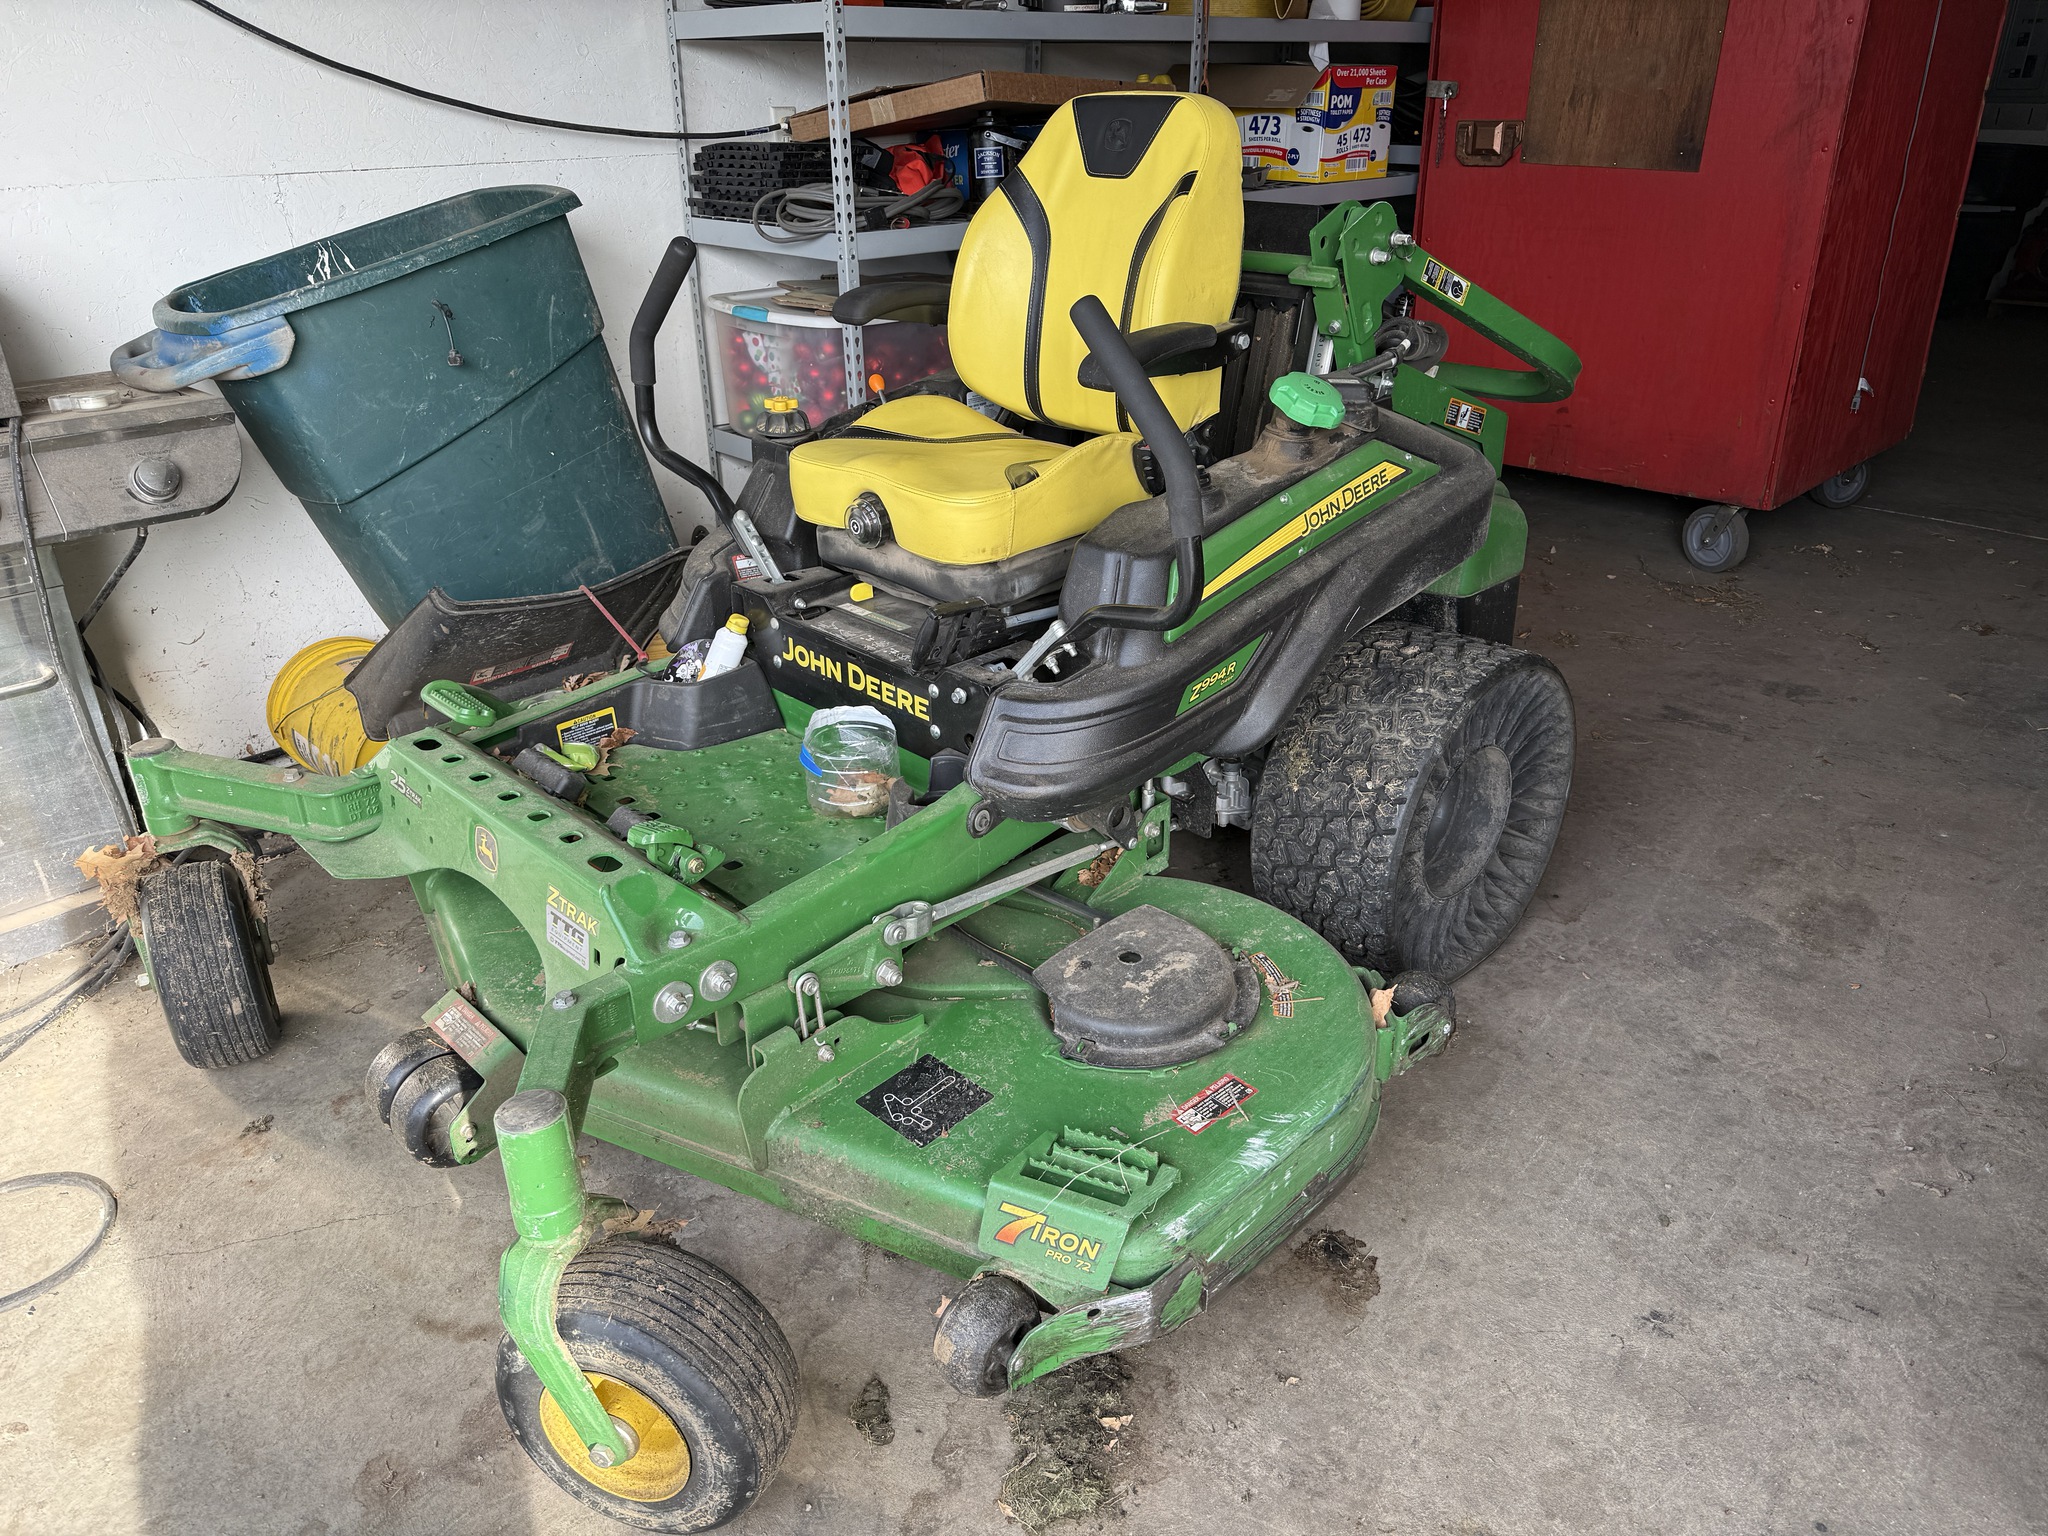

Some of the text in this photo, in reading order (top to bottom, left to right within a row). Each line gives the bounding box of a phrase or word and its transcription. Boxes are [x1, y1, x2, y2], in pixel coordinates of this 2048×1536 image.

[1337, 68, 1387, 77] Over 21,000 Sheets
[1366, 77, 1388, 85] Per Case
[1330, 94, 1354, 109] POM
[1300, 109, 1322, 117] SOFTNESS
[1248, 115, 1281, 136] 473
[1337, 133, 1348, 147] 45
[1352, 127, 1371, 143] 473
[977, 151, 1000, 159] JACKSON
[1335, 146, 1349, 154] ROLLS
[1301, 468, 1389, 535] JOHN DEERE
[782, 636, 930, 722] JOHN DEERE
[1189, 661, 1237, 703] Z994R
[577, 713, 597, 723] CAUTION
[390, 769, 406, 794] 25
[547, 884, 599, 937] ZTRAK
[550, 911, 585, 945] TTG
[551, 927, 583, 952] EQUIPMENT
[1209, 1076, 1230, 1090] PELIGRO
[1181, 1096, 1201, 1110] DANGER
[1045, 1249, 1092, 1273] PRO 72
